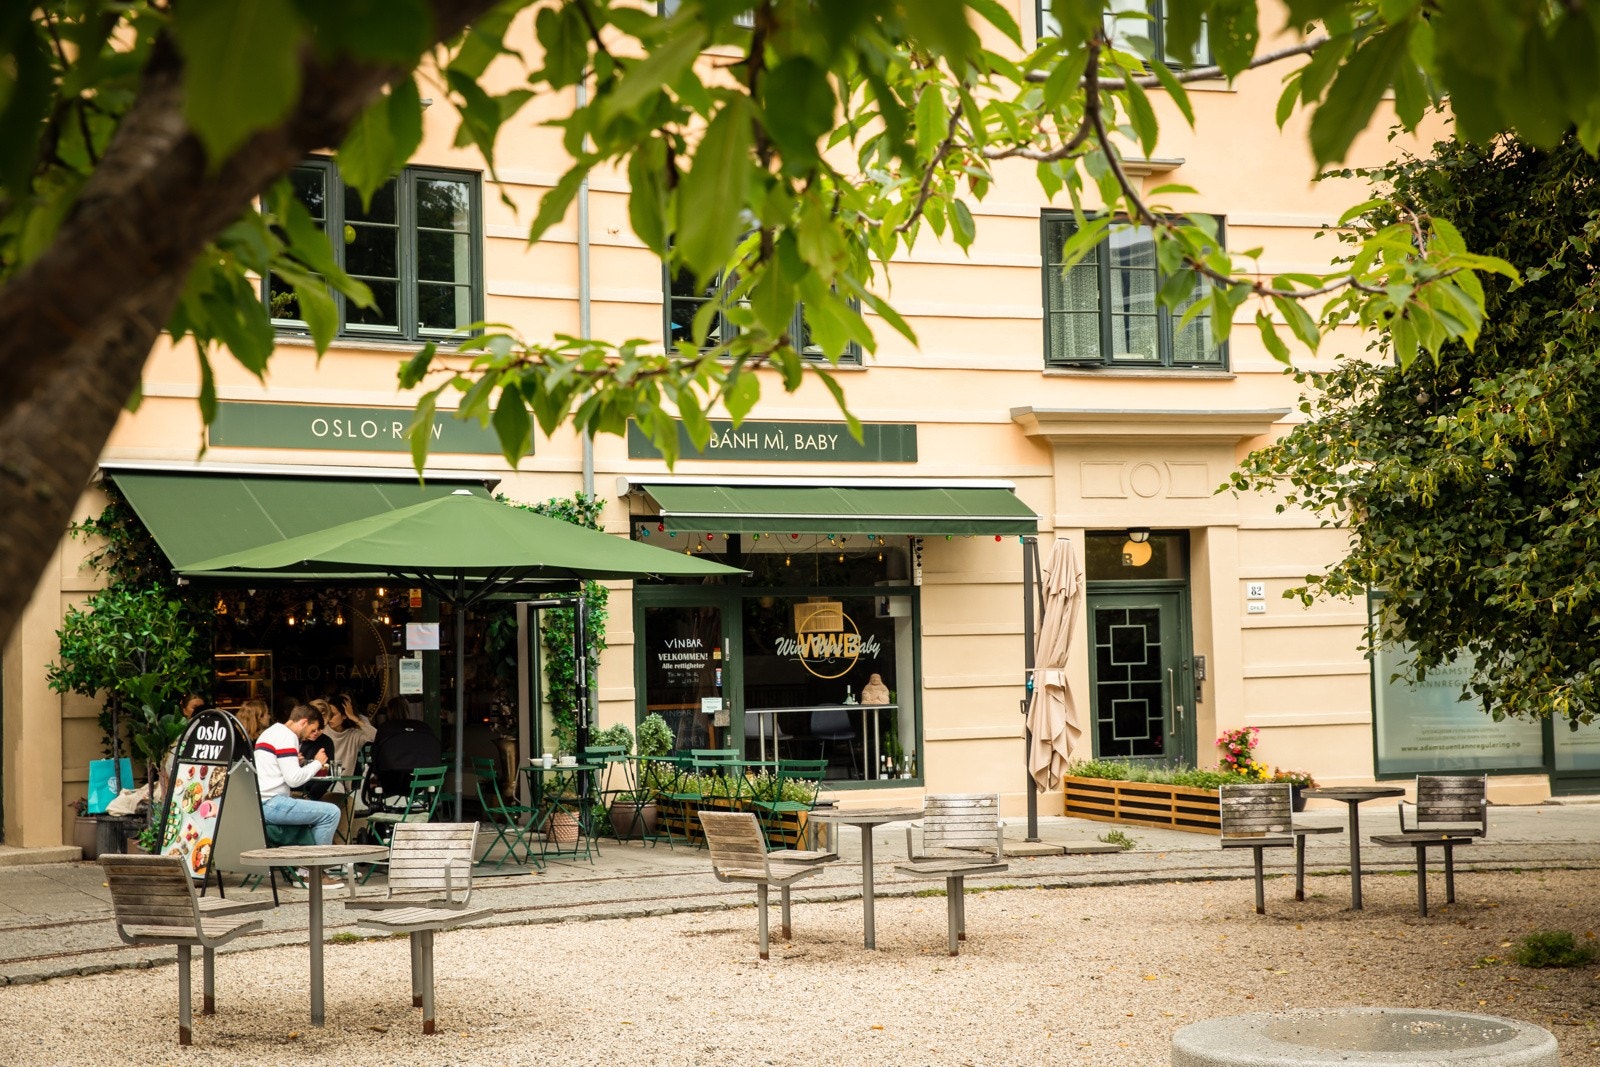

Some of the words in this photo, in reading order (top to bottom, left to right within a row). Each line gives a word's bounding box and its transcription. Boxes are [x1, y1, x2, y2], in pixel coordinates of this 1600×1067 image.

[311, 418, 443, 440] OSLO·RW
[709, 428, 758, 449] BÁNH
[764, 429, 789, 451] MÌ,
[795, 433, 839, 451] BABY
[1251, 586, 1262, 596] 82
[849, 634, 881, 660] Baby
[658, 653, 708, 661] VELKOMMEN!
[196, 721, 227, 742] oslo
[191, 744, 224, 760] raw
[1401, 742, 1521, 752] www.adamstuentannregulering.no
